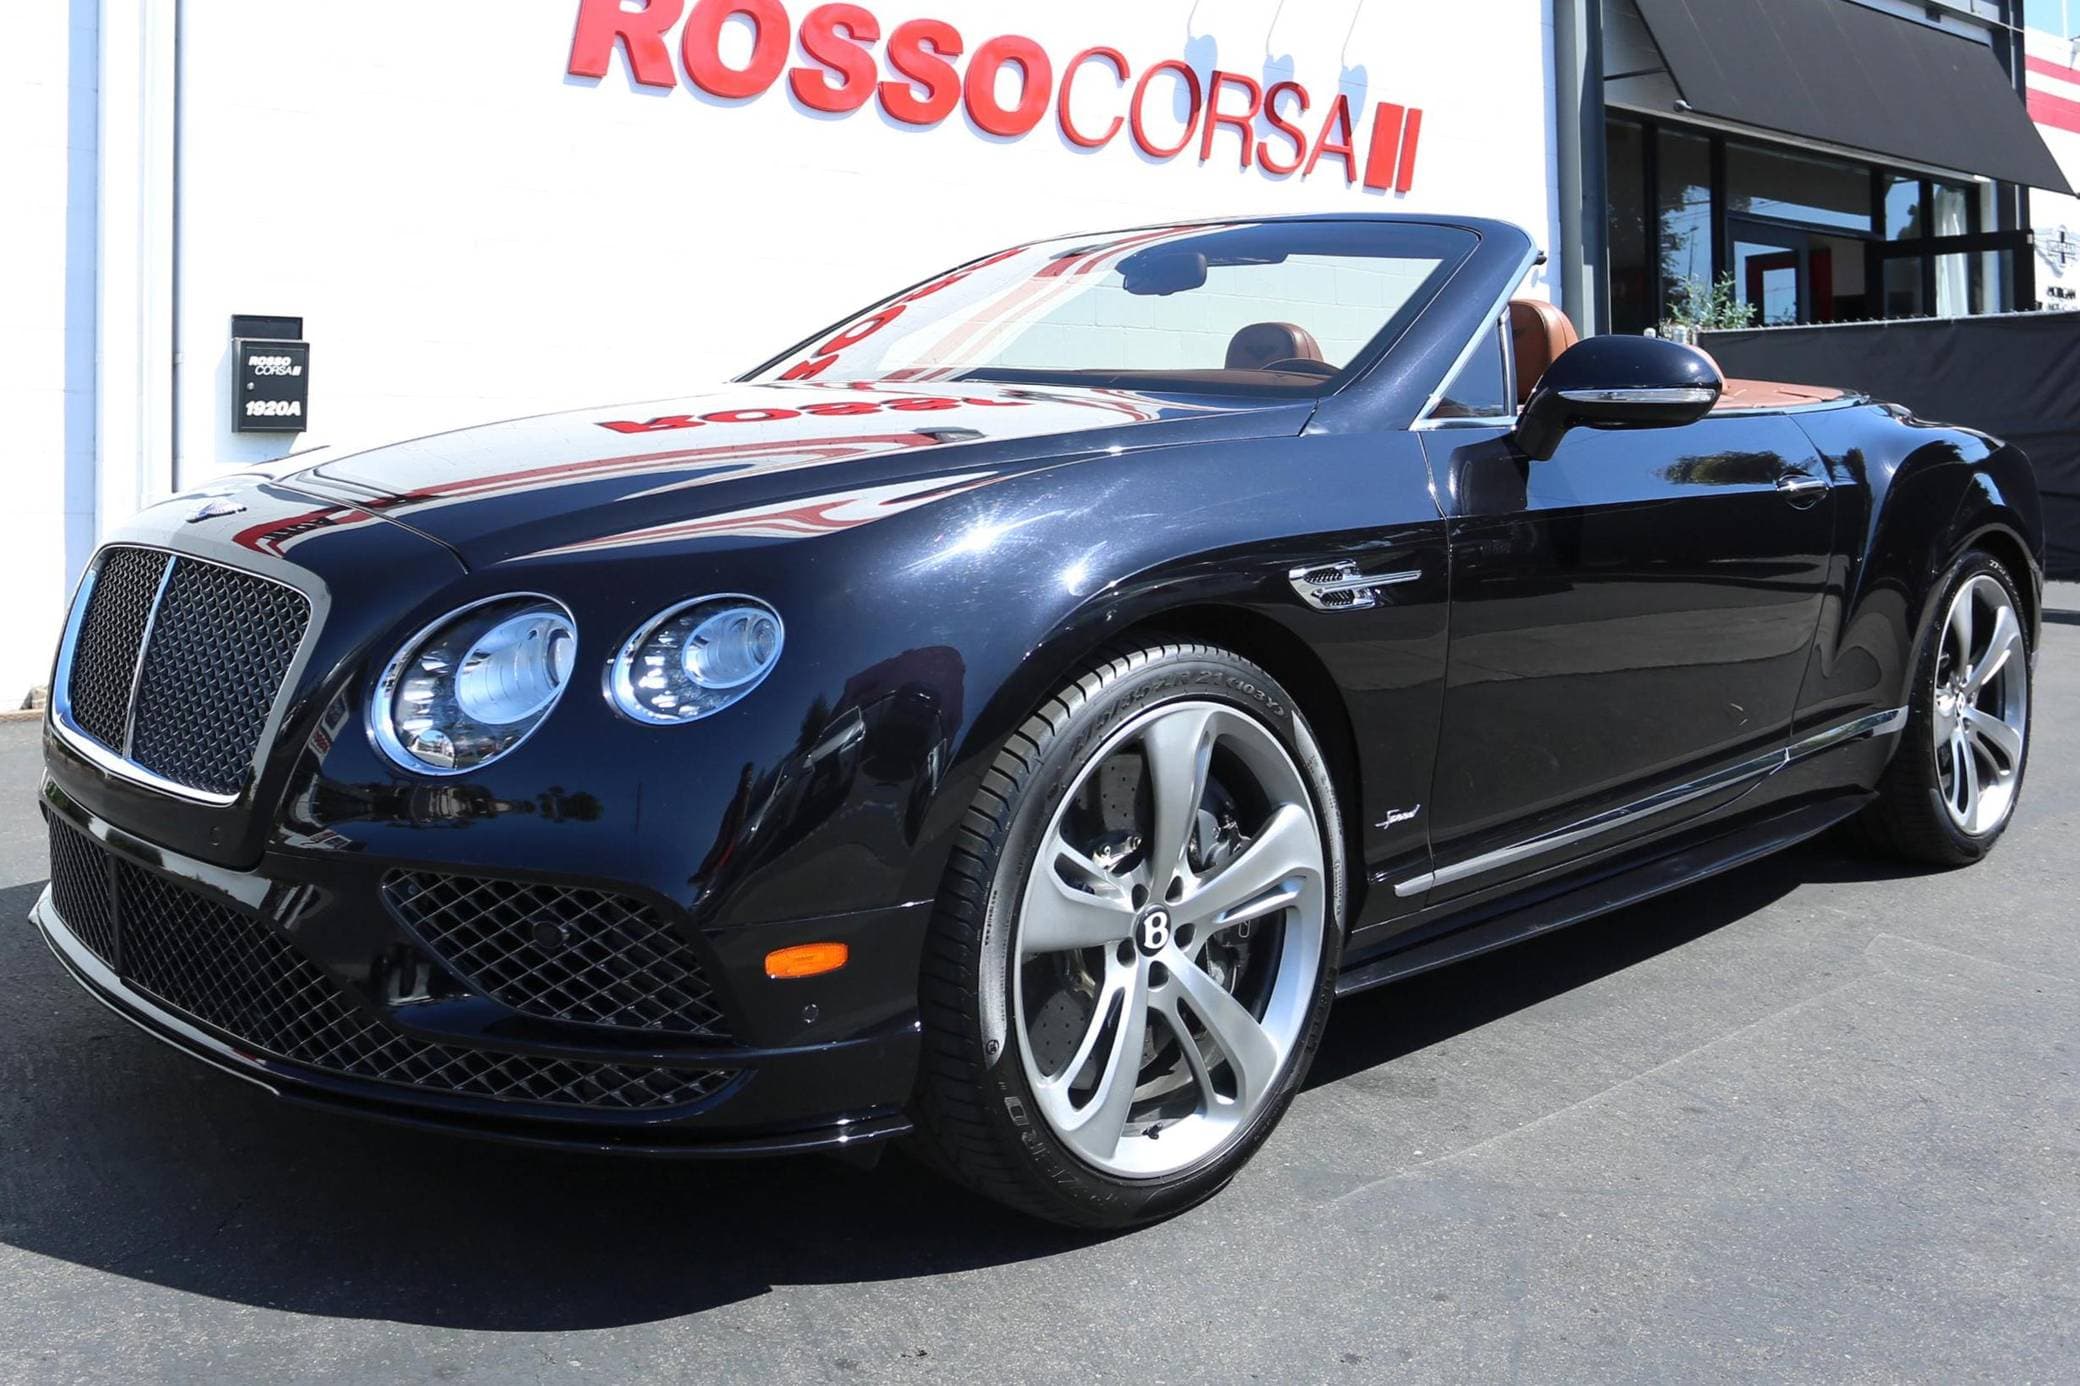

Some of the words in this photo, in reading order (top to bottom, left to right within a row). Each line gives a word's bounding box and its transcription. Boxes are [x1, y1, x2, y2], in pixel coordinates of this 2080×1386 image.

[248, 356, 292, 367] ROSSO
[246, 400, 302, 416] 1920A
[1143, 911, 1169, 950] B
